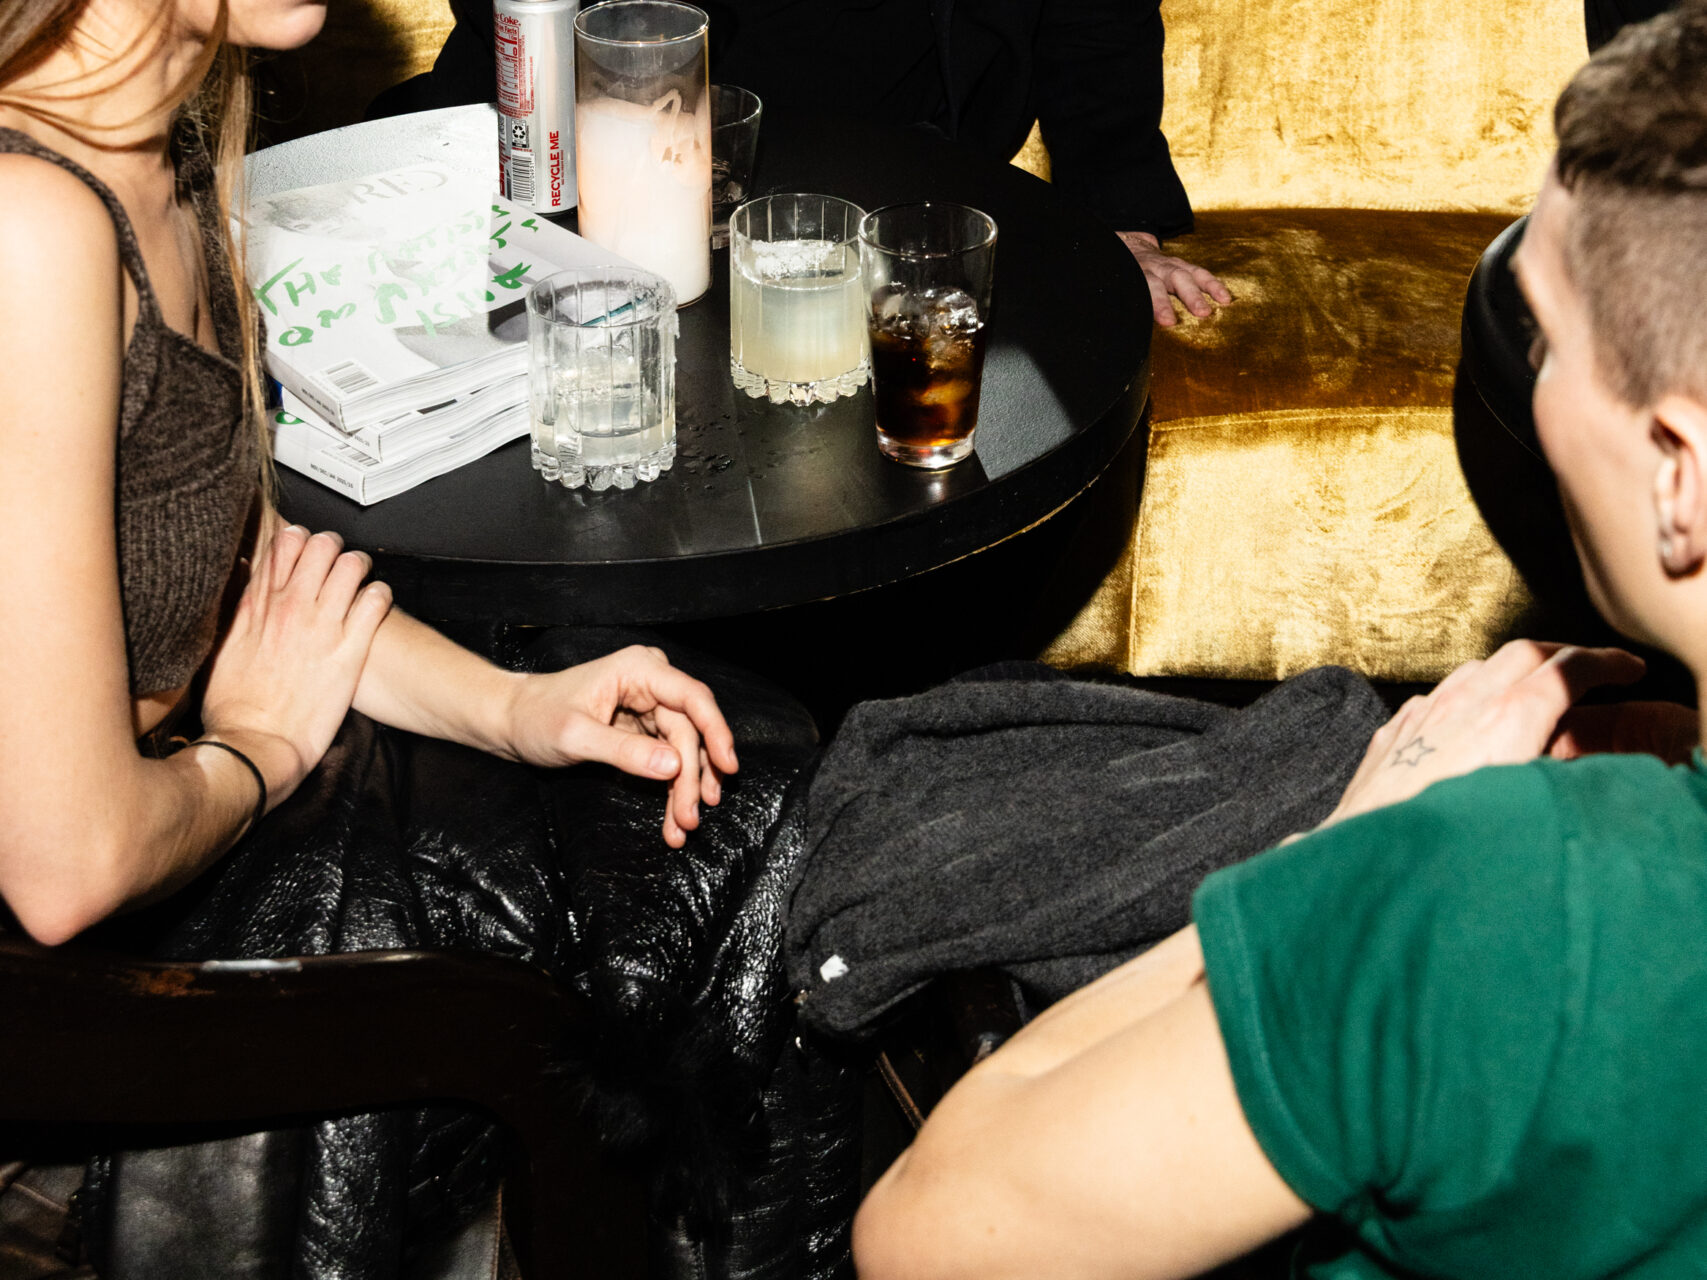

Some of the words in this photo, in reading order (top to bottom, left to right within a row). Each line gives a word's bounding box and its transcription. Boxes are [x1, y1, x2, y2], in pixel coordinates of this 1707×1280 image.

[549, 130, 559, 150] ME
[550, 151, 561, 207] RECYCLE
[253, 257, 342, 317] THE
